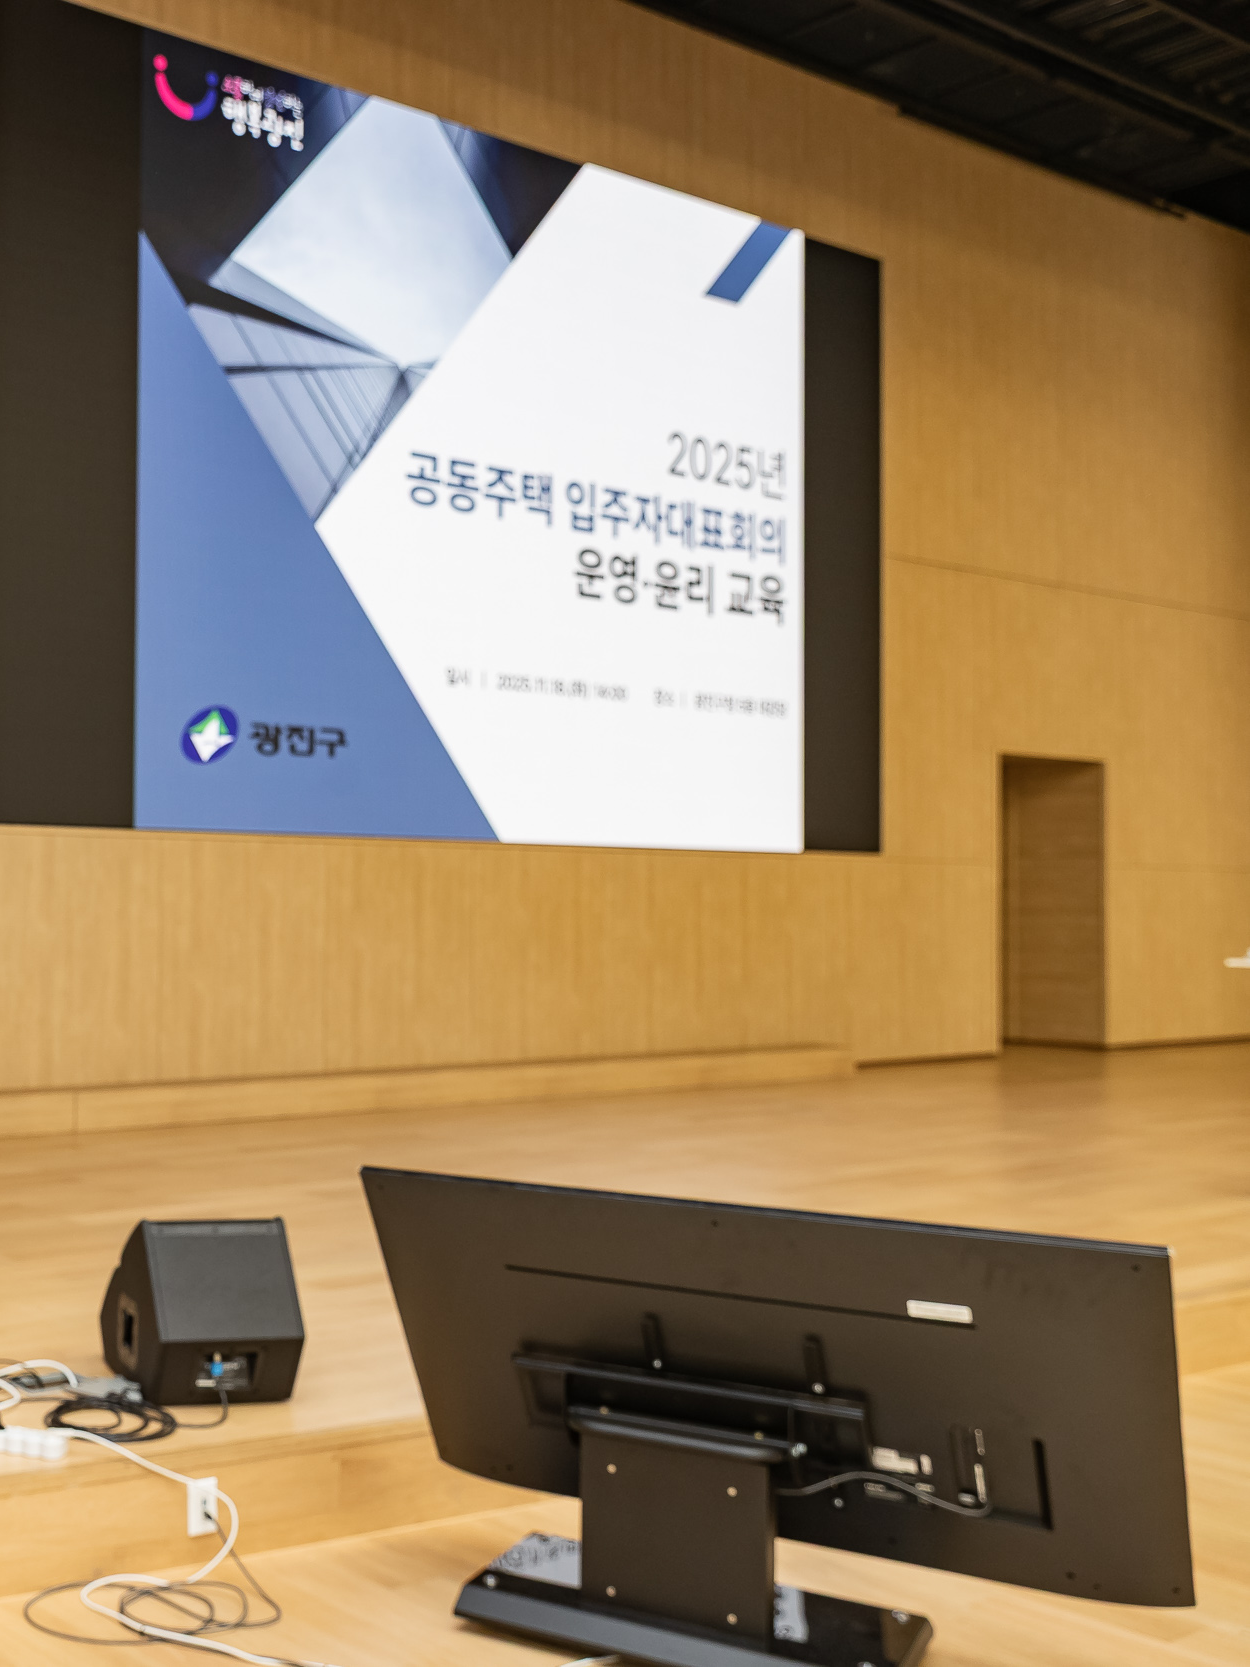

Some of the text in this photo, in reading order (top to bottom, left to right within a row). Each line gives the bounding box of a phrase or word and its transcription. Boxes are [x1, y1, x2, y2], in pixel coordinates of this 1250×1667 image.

[668, 432, 787, 500] 2025년
[407, 451, 787, 565] 공동주택 입주자대표회의
[726, 571, 786, 626] 교육
[250, 722, 348, 759] 광진구
